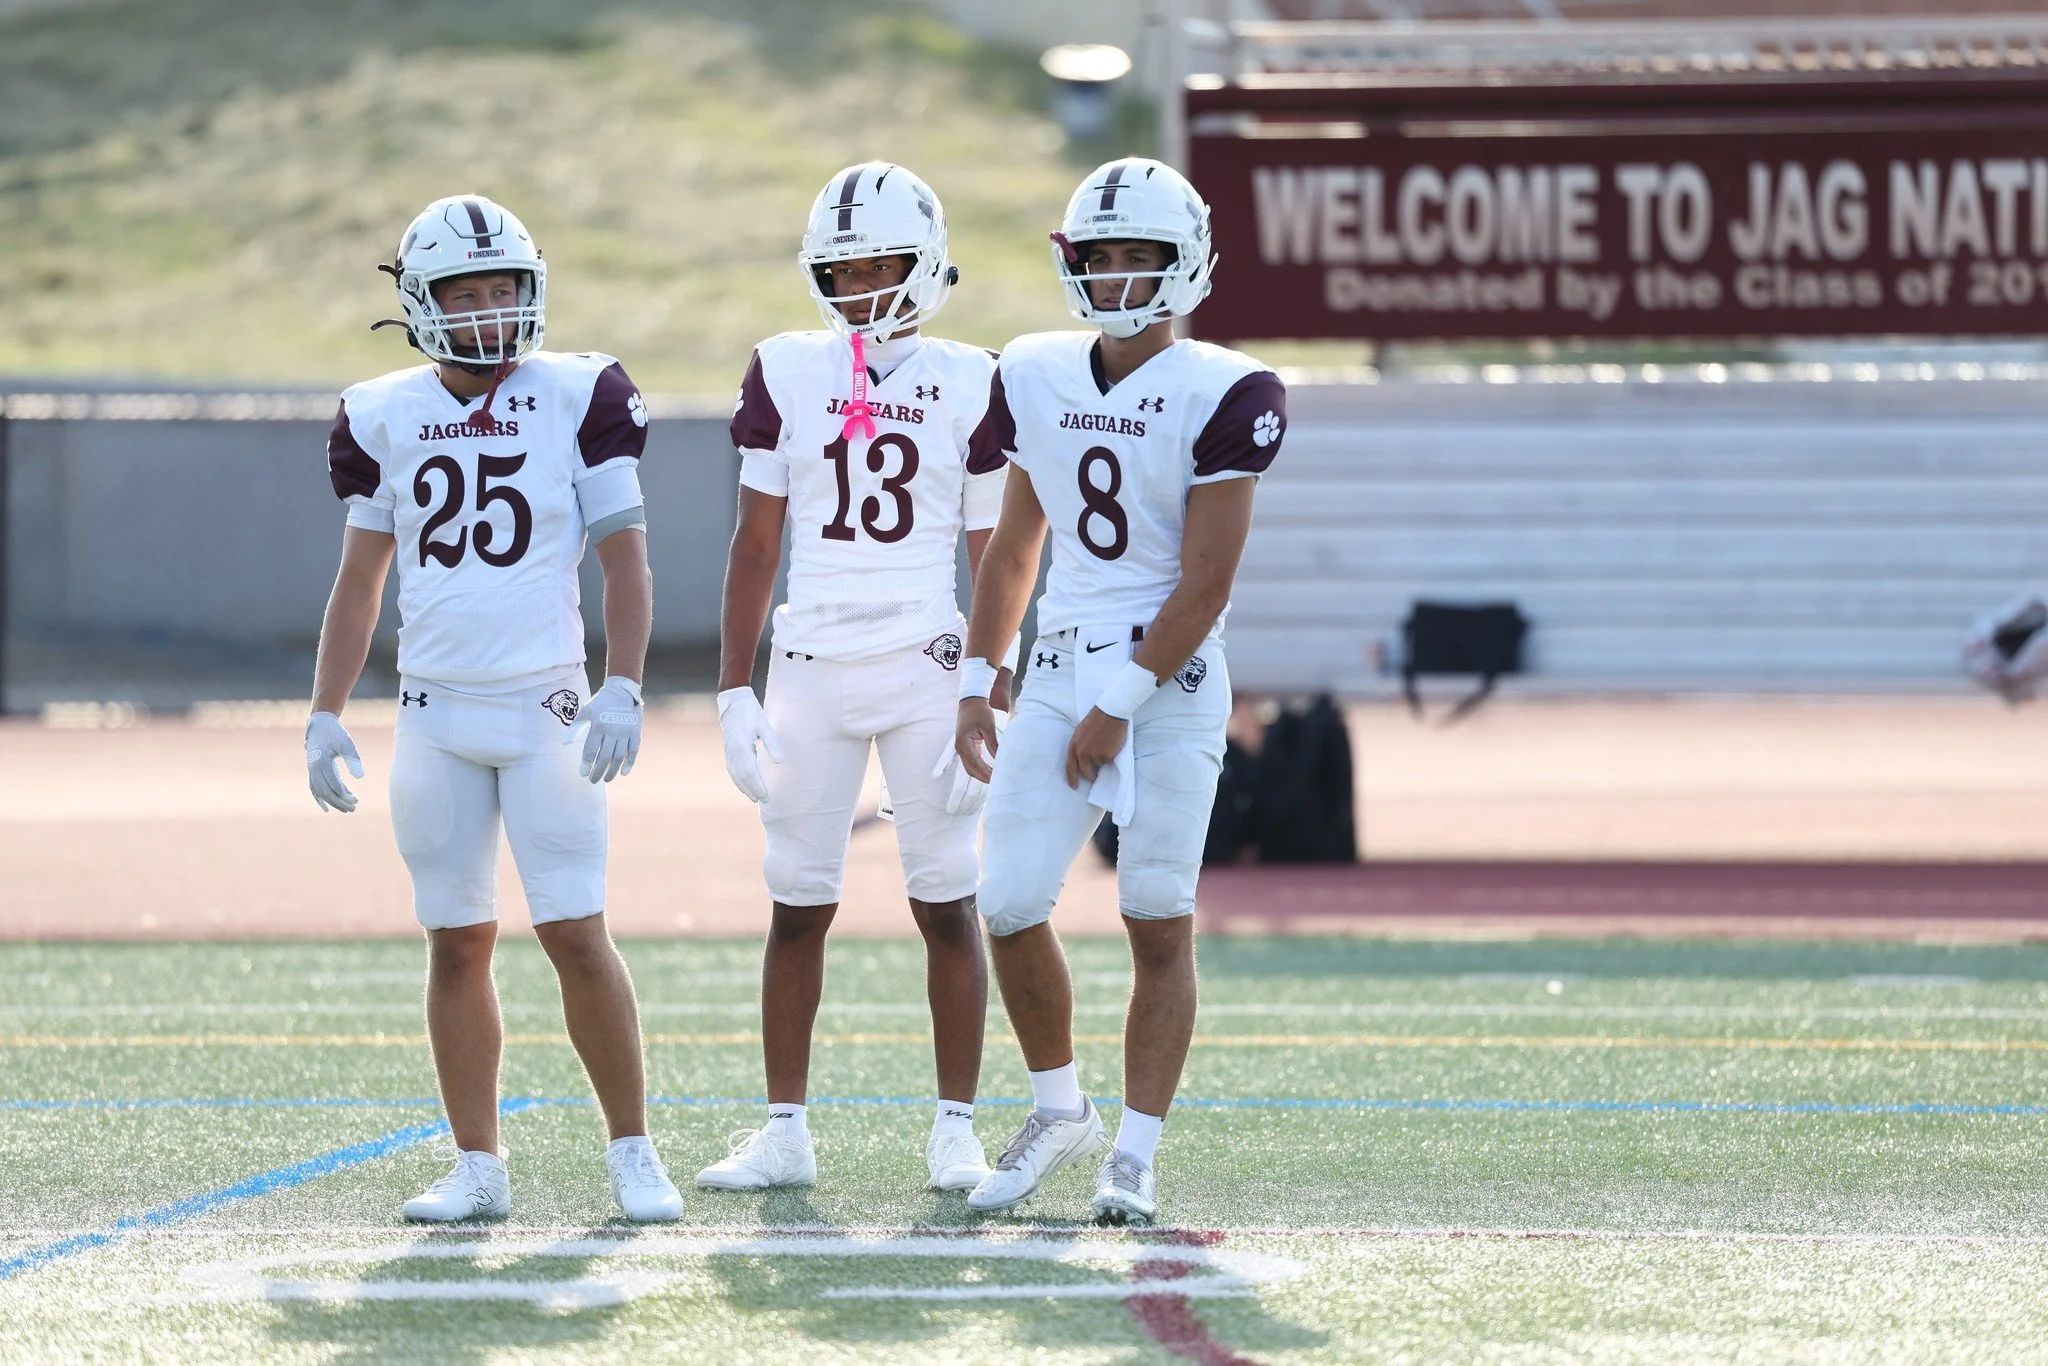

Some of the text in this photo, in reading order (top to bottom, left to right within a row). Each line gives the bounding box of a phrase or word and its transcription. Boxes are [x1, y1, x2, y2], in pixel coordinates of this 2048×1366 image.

[1092, 214, 1118, 223] ONENESS
[1252, 164, 1600, 265] WELCOME
[1614, 161, 1713, 263] TO
[1728, 160, 1869, 261] JAG
[473, 249, 500, 259] ONENESS
[832, 234, 858, 245] ONENESS
[1325, 266, 1545, 312] Donated
[1557, 264, 1620, 321] by
[1634, 263, 1722, 309] the
[1734, 261, 1883, 308] Class
[1896, 260, 1951, 306] of
[854, 372, 865, 401] NXTRND
[826, 398, 924, 425] JAUARS
[1060, 412, 1146, 438] JAGUARS
[821, 430, 919, 544] 13
[412, 451, 533, 569] 25
[1077, 445, 1129, 561] 8
